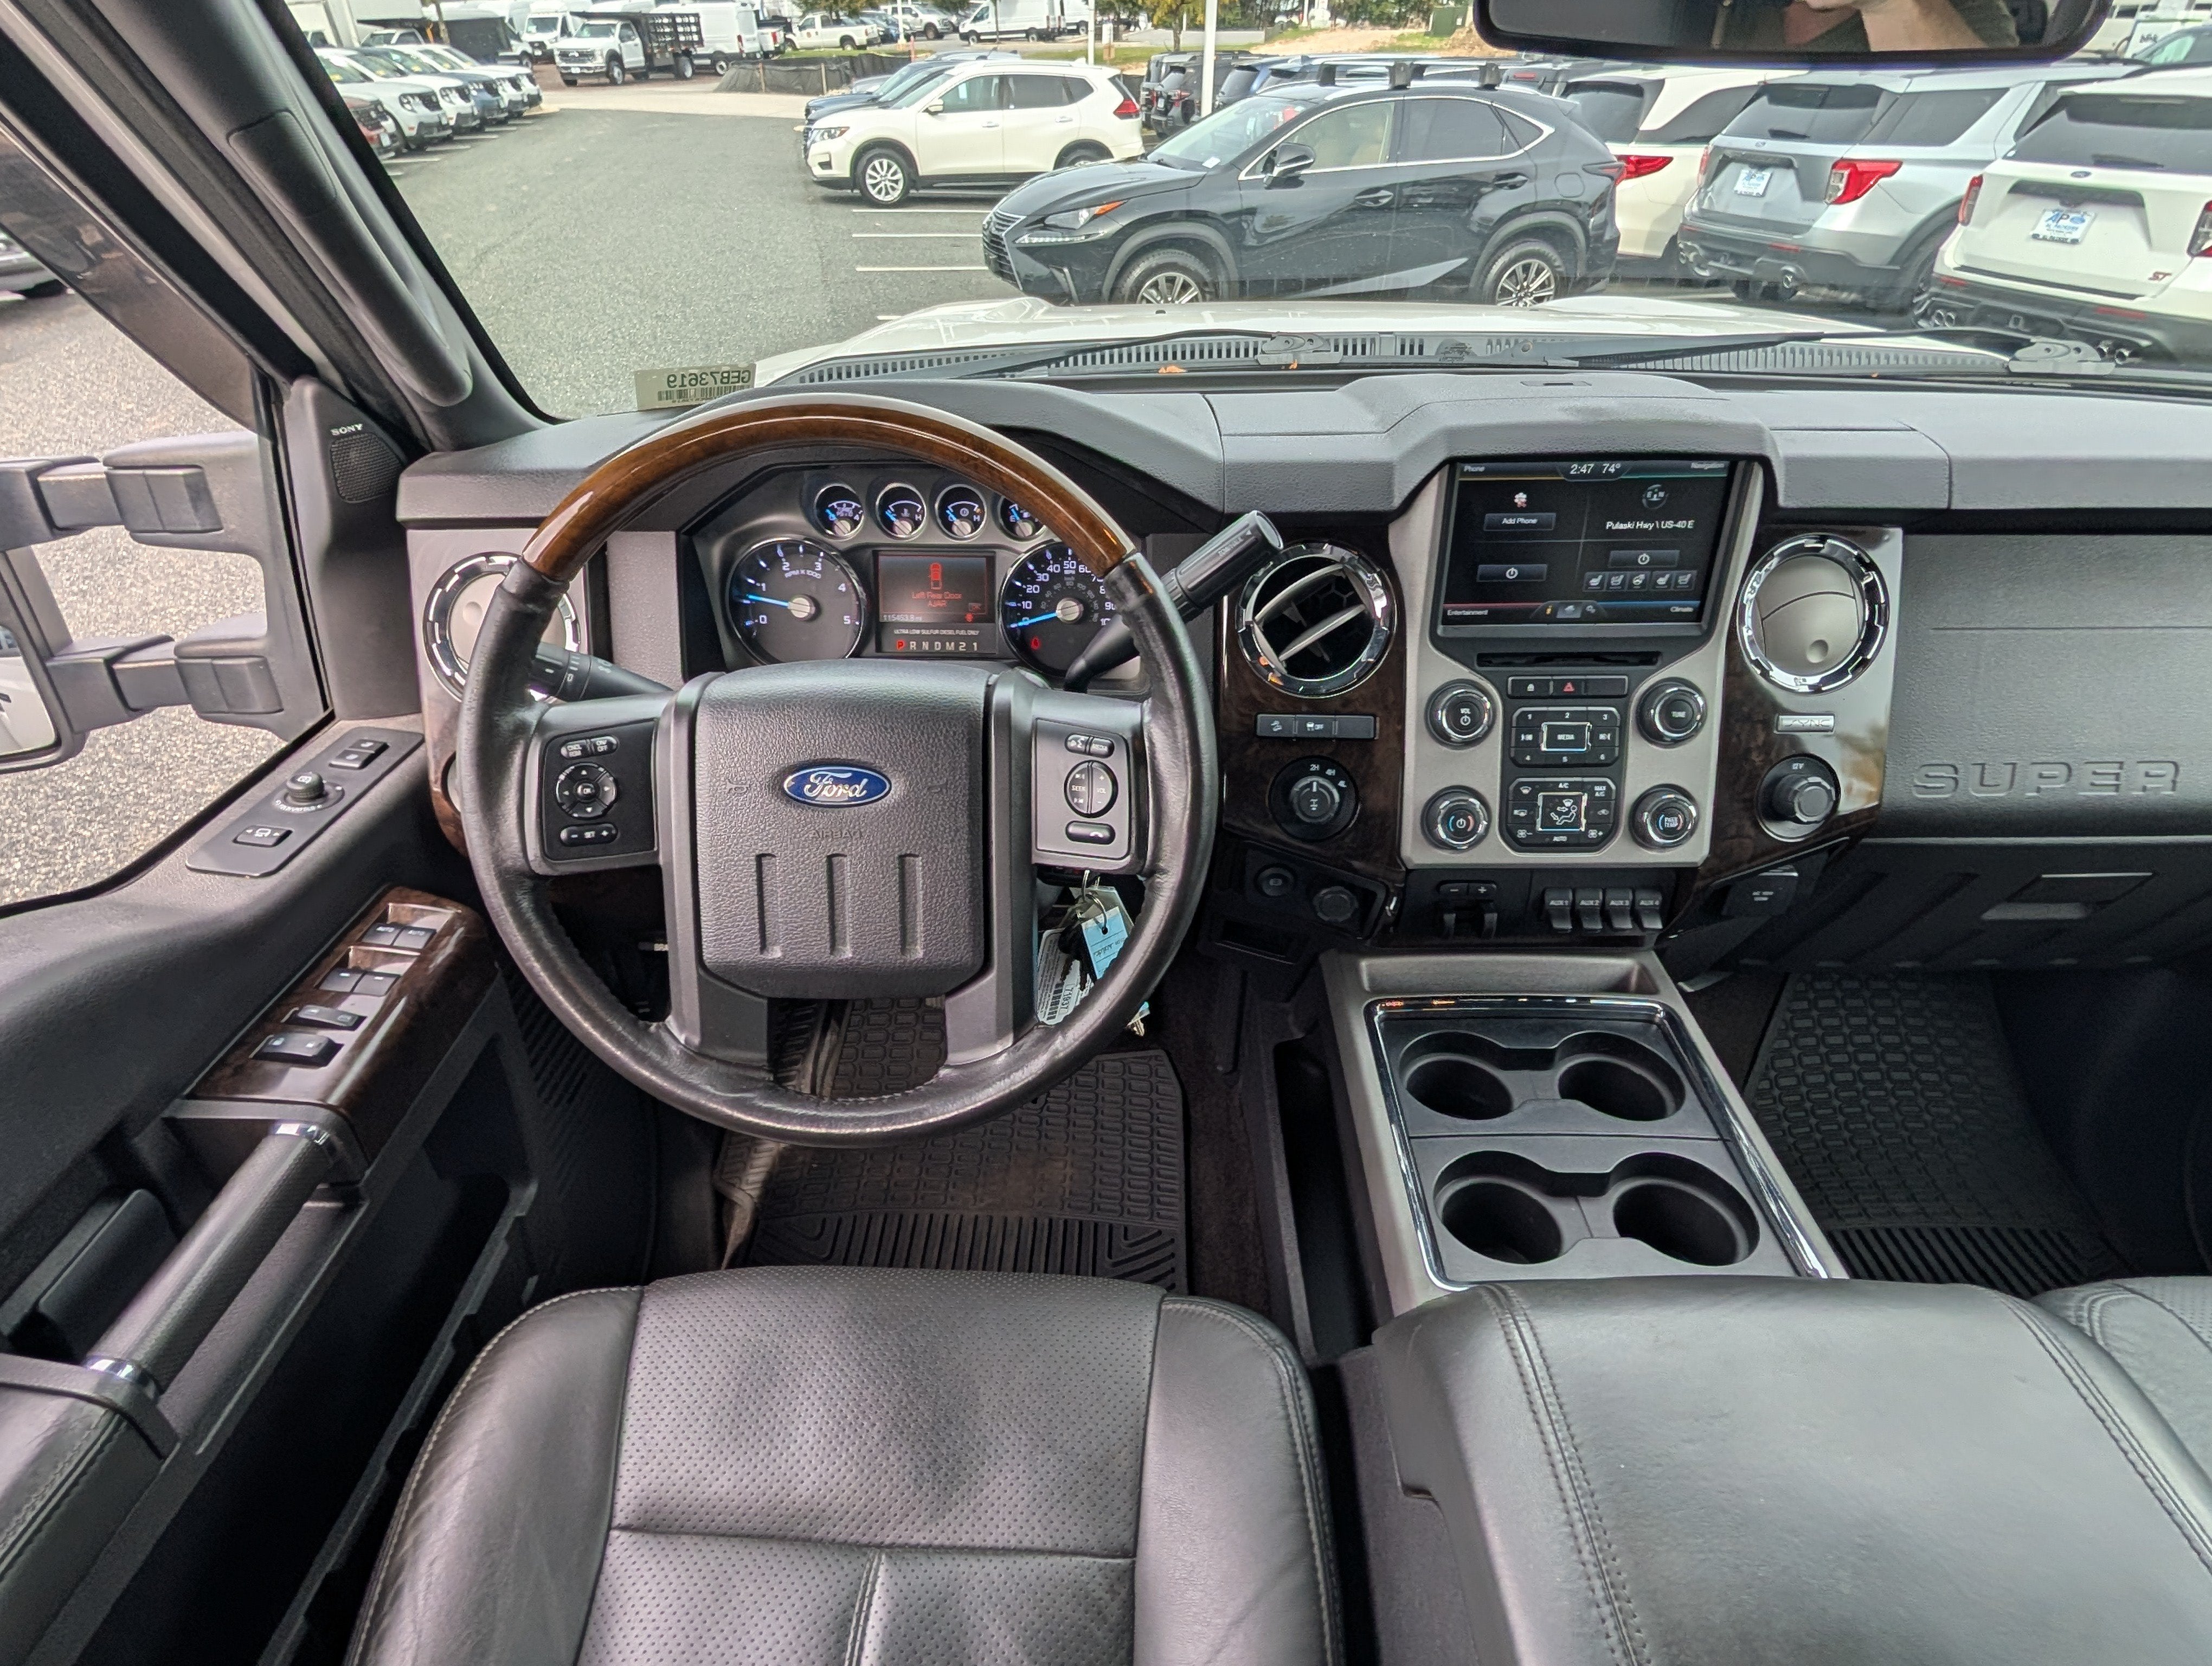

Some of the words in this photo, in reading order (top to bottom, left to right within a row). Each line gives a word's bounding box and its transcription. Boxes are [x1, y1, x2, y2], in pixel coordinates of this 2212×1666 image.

[330, 424, 363, 435] SONY
[1570, 463, 1594, 475] 2:47
[1605, 521, 1635, 530] Pulaski
[1636, 521, 1655, 530] Hwy
[1661, 520, 1686, 529] US-40
[1687, 520, 1695, 529] E
[782, 561, 790, 571] 2
[815, 561, 822, 571] 3
[1046, 564, 1060, 573] 40
[1063, 560, 1077, 569] 50
[1036, 573, 1050, 582] 30
[760, 582, 766, 592] 1
[838, 583, 846, 592] 4
[1026, 585, 1040, 594] 20
[1021, 601, 1032, 610] 10
[759, 614, 768, 624] 0
[844, 616, 851, 624] 5
[897, 640, 904, 650] P
[910, 642, 916, 650] R
[922, 642, 929, 650] N
[935, 642, 941, 650] D
[946, 642, 955, 650] M
[959, 642, 966, 651] 2
[973, 642, 978, 651] 1
[1784, 719, 1831, 727] SYNC
[1912, 760, 2180, 798] SUPER
[803, 771, 869, 798] Ford
